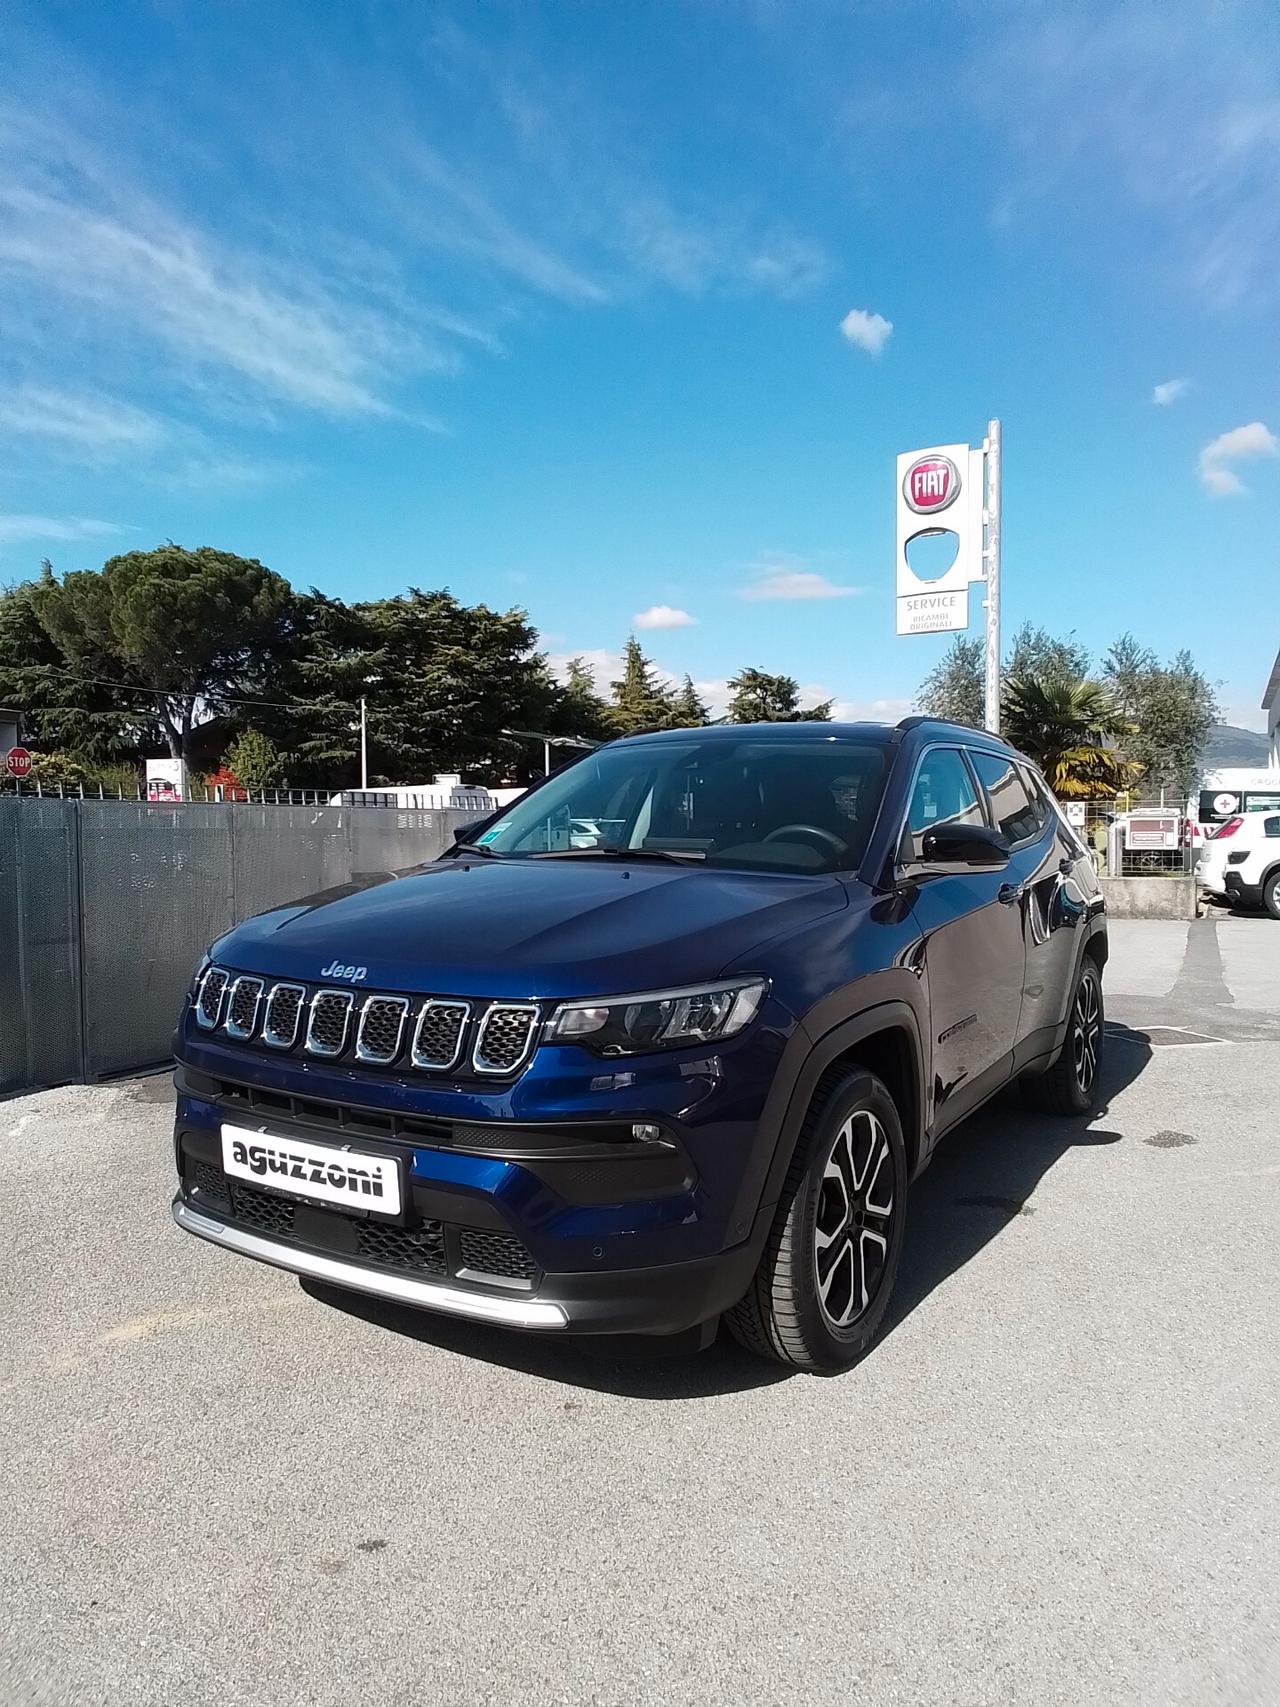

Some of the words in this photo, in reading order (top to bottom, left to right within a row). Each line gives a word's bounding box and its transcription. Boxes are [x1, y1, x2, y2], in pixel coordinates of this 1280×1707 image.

[914, 468, 947, 498] FIAT
[906, 597, 956, 611] SERVICE
[913, 613, 949, 623] RICAMBI
[910, 621, 952, 630] ORIGINALI
[8, 757, 31, 768] STOP
[320, 960, 368, 983] Jeep
[232, 1141, 383, 1197] aguzzoni
